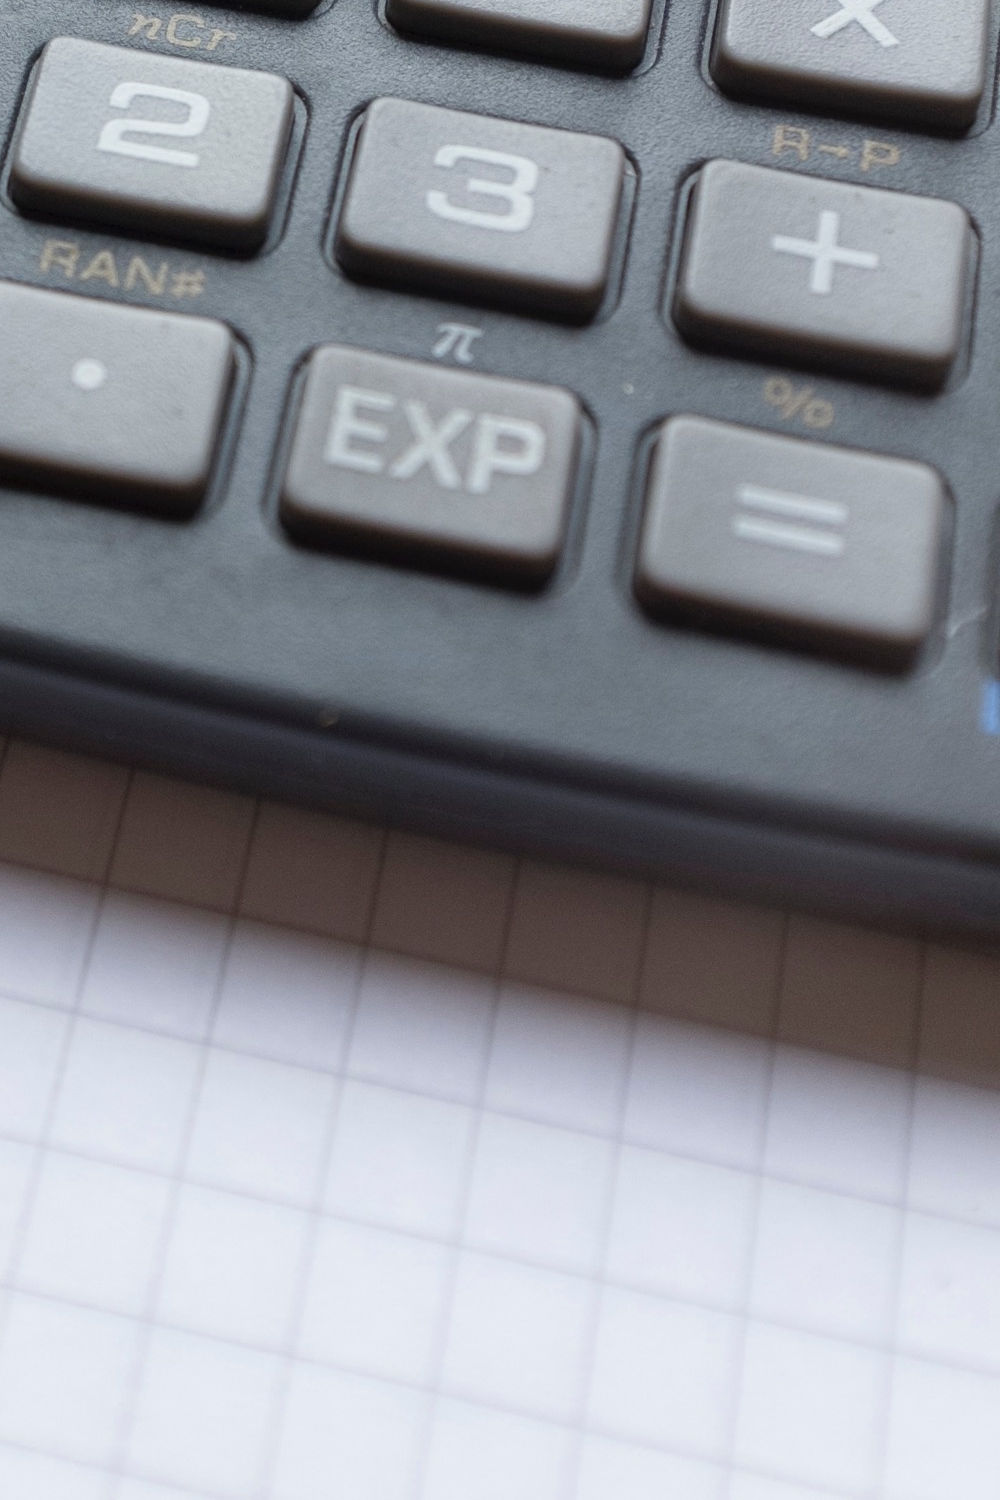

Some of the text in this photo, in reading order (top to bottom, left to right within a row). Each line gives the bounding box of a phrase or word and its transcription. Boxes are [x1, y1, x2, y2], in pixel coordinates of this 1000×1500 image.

[128, 10, 238, 52] nCr
[97, 80, 211, 169] 2
[426, 144, 540, 233] 3
[38, 239, 206, 299] RAN#
[432, 321, 484, 364] π
[763, 376, 835, 430] %
[324, 384, 546, 496] EXP
